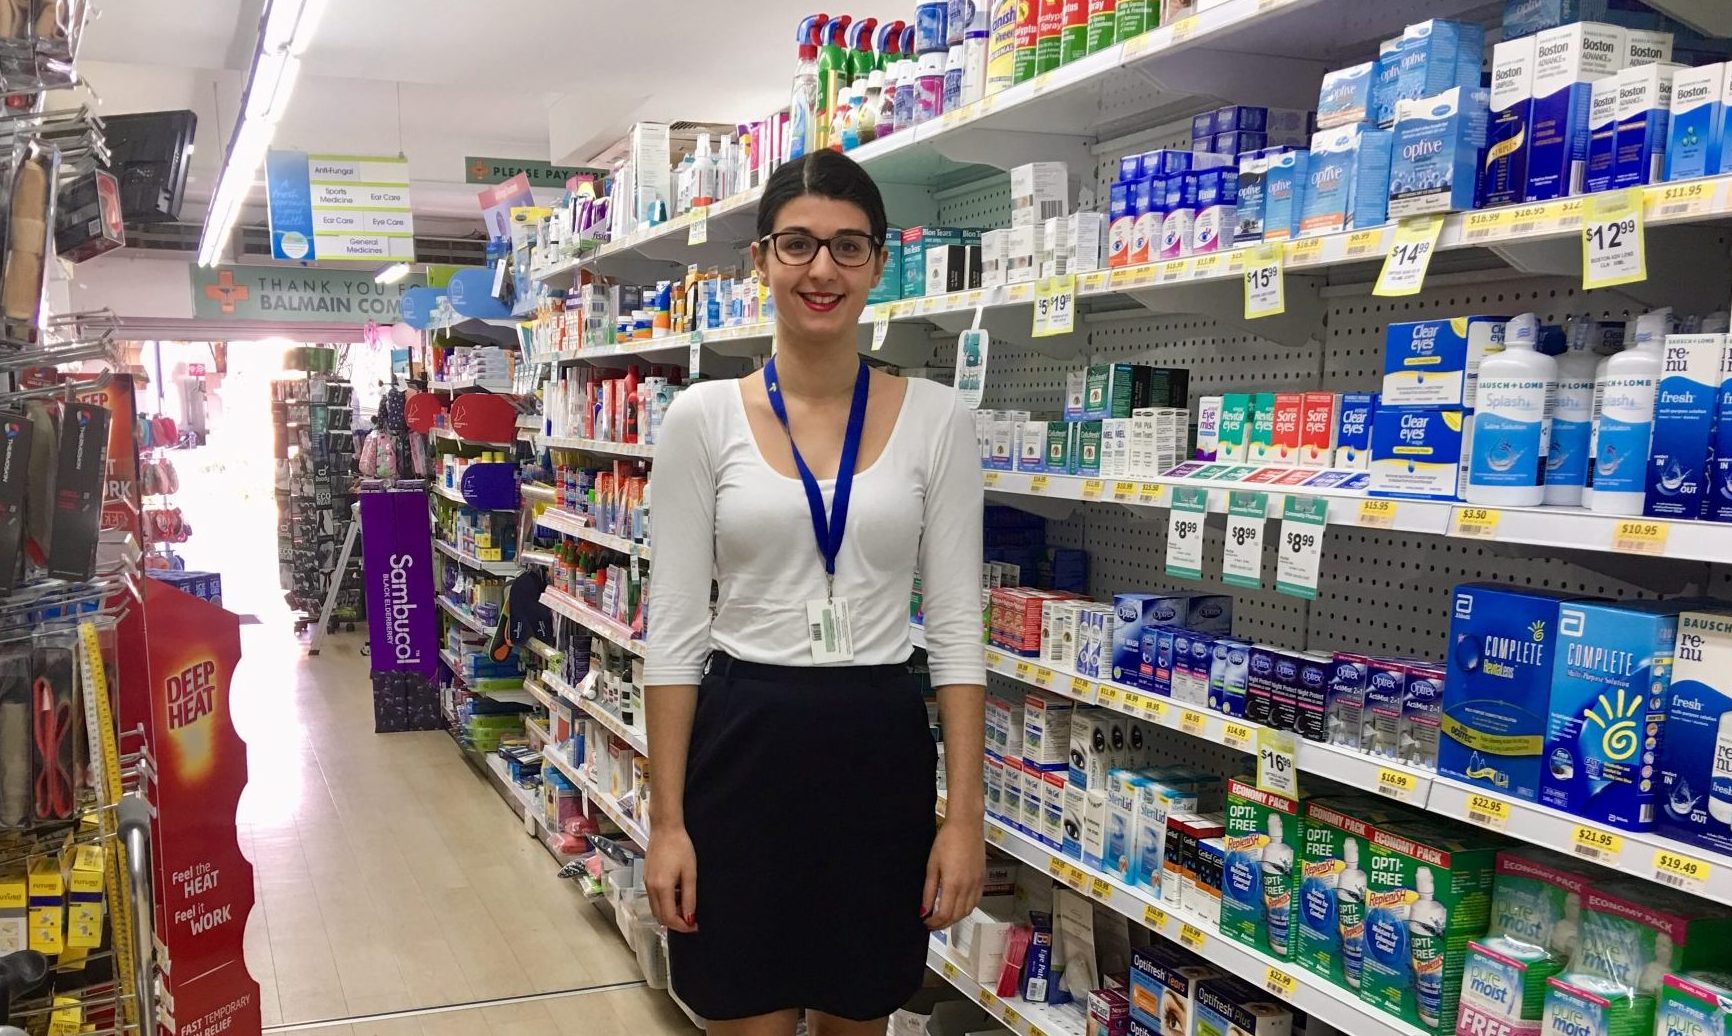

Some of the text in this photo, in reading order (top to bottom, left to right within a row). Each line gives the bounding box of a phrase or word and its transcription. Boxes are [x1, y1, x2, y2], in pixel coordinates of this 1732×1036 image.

[1539, 41, 1568, 58] Boston
[1582, 37, 1614, 53] Boston
[1630, 44, 1662, 60] Boston
[1381, 66, 1400, 83] optiv
[1495, 65, 1522, 81] Boston
[1620, 86, 1645, 102] Boston
[1678, 87, 1708, 103] Boston
[1593, 95, 1616, 111] Boston
[1402, 139, 1443, 166] optive
[315, 167, 353, 176] Anti-Fungal
[493, 166, 568, 182] PLEASE PAY
[1311, 165, 1342, 191] optive
[325, 187, 346, 196] Sports
[371, 194, 400, 202] Ear Care
[1665, 186, 1702, 199] $11.95
[320, 196, 353, 205] Medicine
[323, 216, 353, 225] Ear Care
[373, 217, 404, 228] Eye Care
[346, 246, 383, 255] Medicines
[350, 238, 378, 247] General
[258, 278, 385, 298] THANK YOU
[259, 294, 401, 315] BALMAIN COM
[1413, 324, 1439, 339] Clear
[1411, 337, 1434, 353] eyes
[1665, 359, 1687, 372] nu
[1519, 381, 1543, 390] LOMB
[1661, 391, 1693, 404] fresh
[1201, 409, 1215, 422] Eye
[1277, 410, 1297, 423] Sore
[1307, 409, 1327, 422] Sore
[1343, 411, 1367, 425] Clear
[1400, 414, 1429, 429] Clear
[1199, 421, 1215, 433] mist
[1222, 422, 1240, 435] eyes
[1276, 422, 1295, 436] eyes
[1306, 421, 1326, 437] eyes
[1343, 424, 1363, 440] eyes
[1399, 427, 1425, 444] eyes
[1680, 485, 1697, 494] OUT
[1363, 501, 1388, 513] $15.95
[1462, 510, 1487, 523] $3.50
[1621, 524, 1657, 536] $10.95
[382, 572, 393, 645] BLACK ELDERBERRY
[389, 553, 421, 664] Sambucol
[1683, 617, 1732, 633] BAUSCH
[1485, 635, 1544, 666] COMPLETE
[1678, 646, 1703, 662] nu
[1567, 643, 1633, 677] COMPLETE
[166, 660, 216, 703] DEEP
[1337, 664, 1359, 683] Optrex
[1372, 672, 1396, 692] Optrex
[1411, 681, 1435, 700] Optrex
[168, 685, 216, 730] HEAT
[1672, 694, 1704, 711] fresh
[1380, 771, 1406, 787] $16.99
[1233, 783, 1290, 812] ECONOMY PACK
[1471, 794, 1502, 812] $22.95
[1229, 805, 1257, 820] OPTI-
[1229, 819, 1257, 832] FREE
[1690, 815, 1707, 829] OUT
[1306, 829, 1333, 845] OPTI-
[1578, 827, 1612, 846] $21.95
[1306, 844, 1333, 857] FREE
[1373, 831, 1442, 866] ECONOMY PACK
[1371, 856, 1404, 876] OPTI-
[1659, 854, 1698, 875] $19.49
[172, 862, 211, 886] Feel the
[1371, 871, 1404, 888] FREE
[1502, 859, 1583, 893] ECONOMY PACK
[184, 870, 219, 899] HEAT
[175, 904, 205, 925] Feel it
[190, 904, 233, 936] WORK
[1588, 895, 1674, 935] ECONOMY PACK
[1499, 914, 1543, 940] moist
[1133, 952, 1186, 993] Optifresh Tears
[1269, 968, 1291, 985] $22.99
[1471, 964, 1501, 986] pure
[1470, 977, 1508, 1004] moist
[1198, 986, 1253, 1026] Optifresh Plus
[180, 994, 252, 1036] FAST TEMPORARY
[1460, 1008, 1511, 1036] FREE
[204, 1016, 233, 1036] RELIEF
